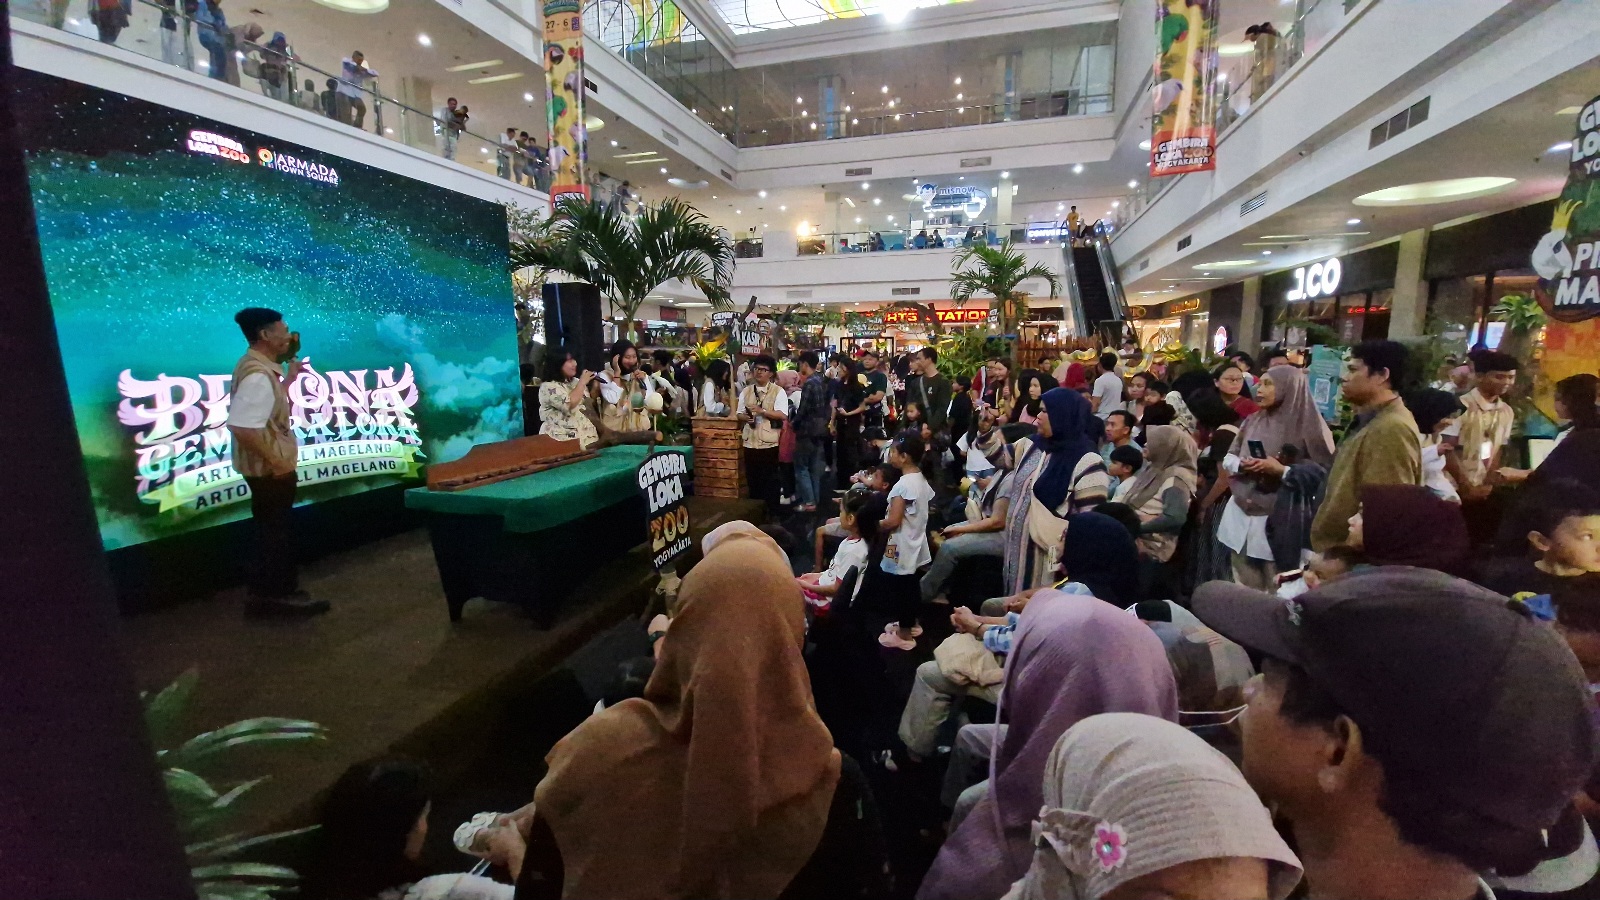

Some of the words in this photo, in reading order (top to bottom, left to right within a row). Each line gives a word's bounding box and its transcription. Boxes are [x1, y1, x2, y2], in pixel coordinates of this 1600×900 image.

[546, 20, 555, 29] 27
[563, 19, 568, 27] 6
[219, 146, 250, 164] ZOO
[277, 154, 339, 178] ARMADA
[278, 164, 305, 176] TOWN
[306, 171, 339, 186] SQUARE
[939, 185, 976, 195] misnow
[929, 310, 988, 321] TATION
[313, 442, 393, 461] MAGELANG
[317, 459, 397, 480] MAGELANG
[638, 453, 687, 490] GEMBIRA
[648, 474, 684, 513] LOKA
[650, 504, 689, 553] ZOO
[653, 536, 692, 569] YOGYAKARTA
